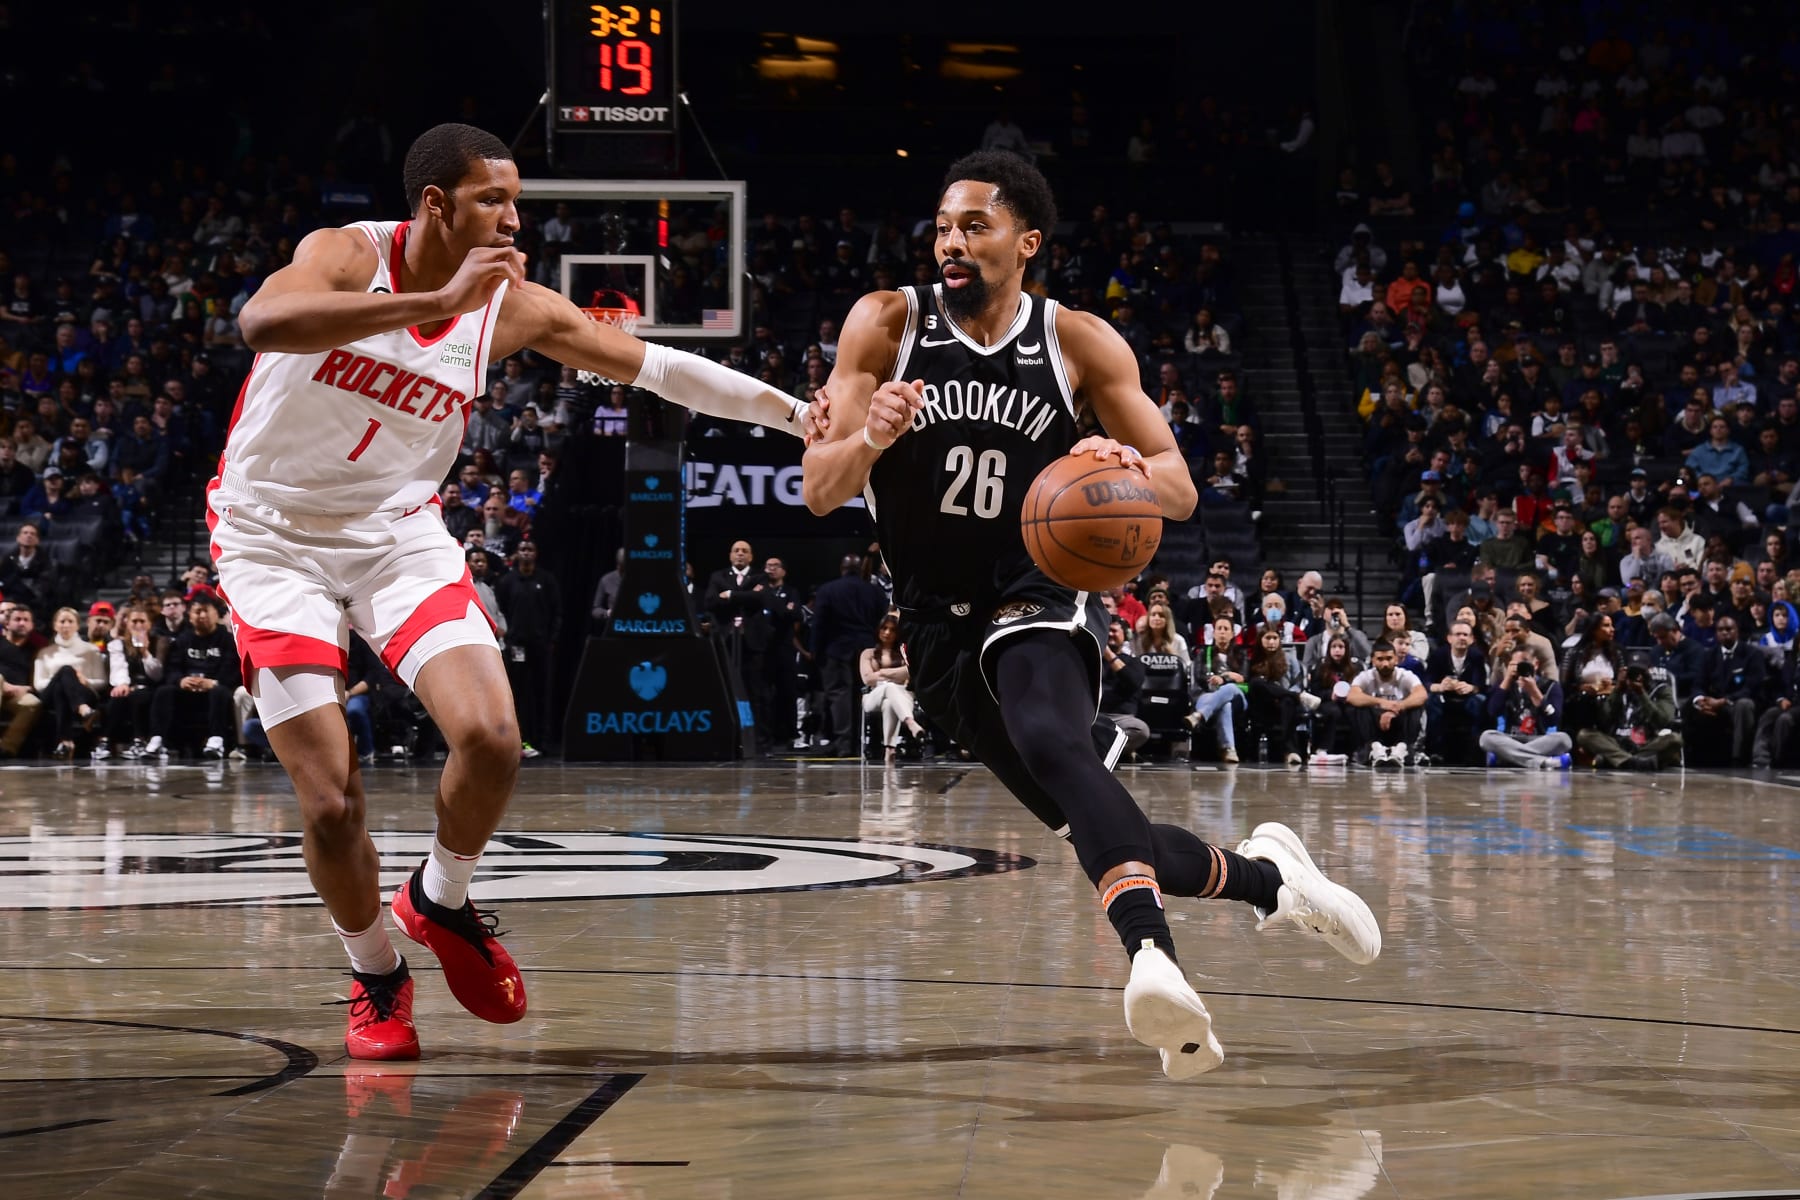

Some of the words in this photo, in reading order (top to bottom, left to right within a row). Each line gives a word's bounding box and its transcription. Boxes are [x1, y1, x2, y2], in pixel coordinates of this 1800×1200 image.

[590, 5, 661, 37] 3:21
[600, 40, 652, 95] 19
[590, 107, 669, 121] TISSOT
[924, 314, 938, 330] 6
[444, 343, 472, 355] credit
[440, 351, 471, 367] karma
[1016, 356, 1044, 365] Webull
[311, 348, 466, 423] ROCKETS
[347, 417, 382, 462] 1
[940, 446, 1007, 519] 26
[630, 492, 674, 501] BARCLAYS
[1081, 479, 1160, 508] Wilson
[629, 550, 673, 559] BARCLAYS
[614, 619, 685, 633] BARCLAYS
[1140, 655, 1178, 665] QATAR
[586, 711, 712, 734] BARCLAYS
